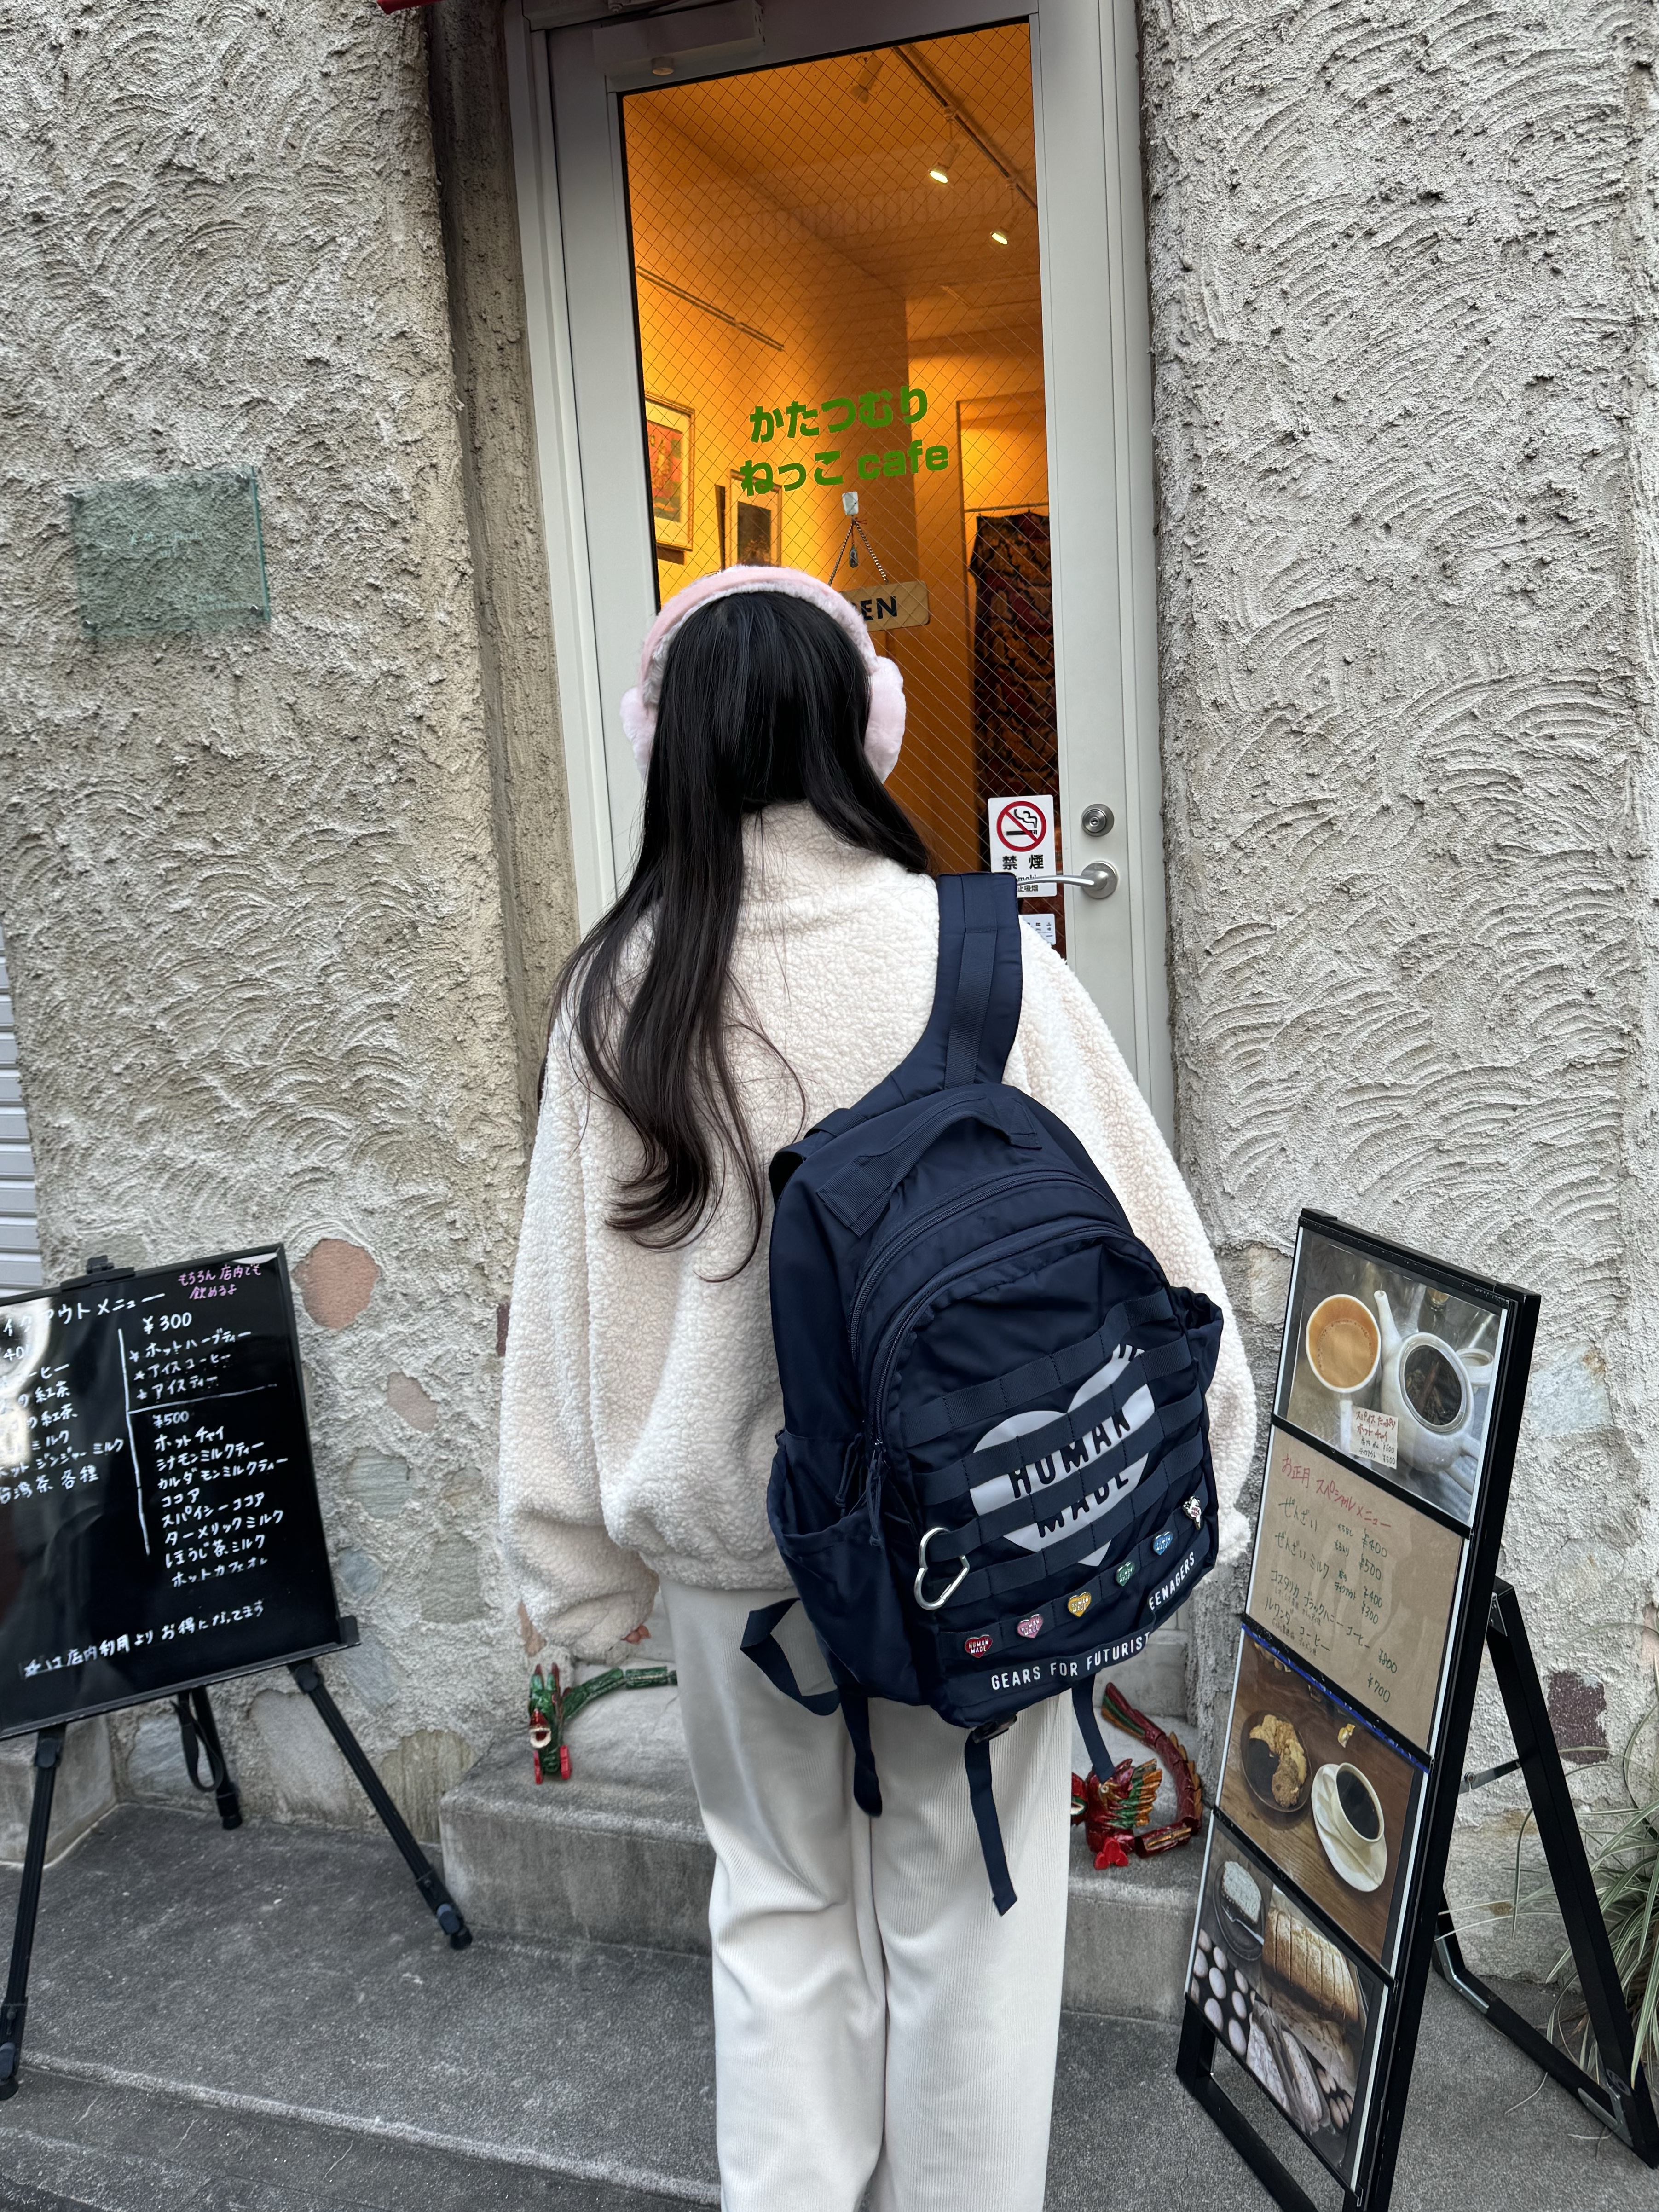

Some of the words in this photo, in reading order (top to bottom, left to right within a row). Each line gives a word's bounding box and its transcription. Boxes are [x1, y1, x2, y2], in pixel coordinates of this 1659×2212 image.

[750, 385, 928, 443] かたつむり
[740, 451, 844, 496] ねっこ
[858, 440, 948, 479] cafe
[851, 596, 897, 620] EN
[1002, 854, 1044, 870] 禁煙
[190, 1284, 237, 1299] 飲めるよ
[152, 1411, 189, 1428] ¥500
[1008, 1410, 1130, 1499] HUMAN
[1282, 1454, 1310, 1488] お正月
[162, 1488, 200, 1507] ココア
[1278, 1497, 1317, 1532] ぜんざい
[969, 1639, 988, 1649] HUMAN
[971, 1645, 986, 1654] MADE
[991, 1666, 1040, 1690] GEARS
[1050, 1662, 1078, 1677] FOR
